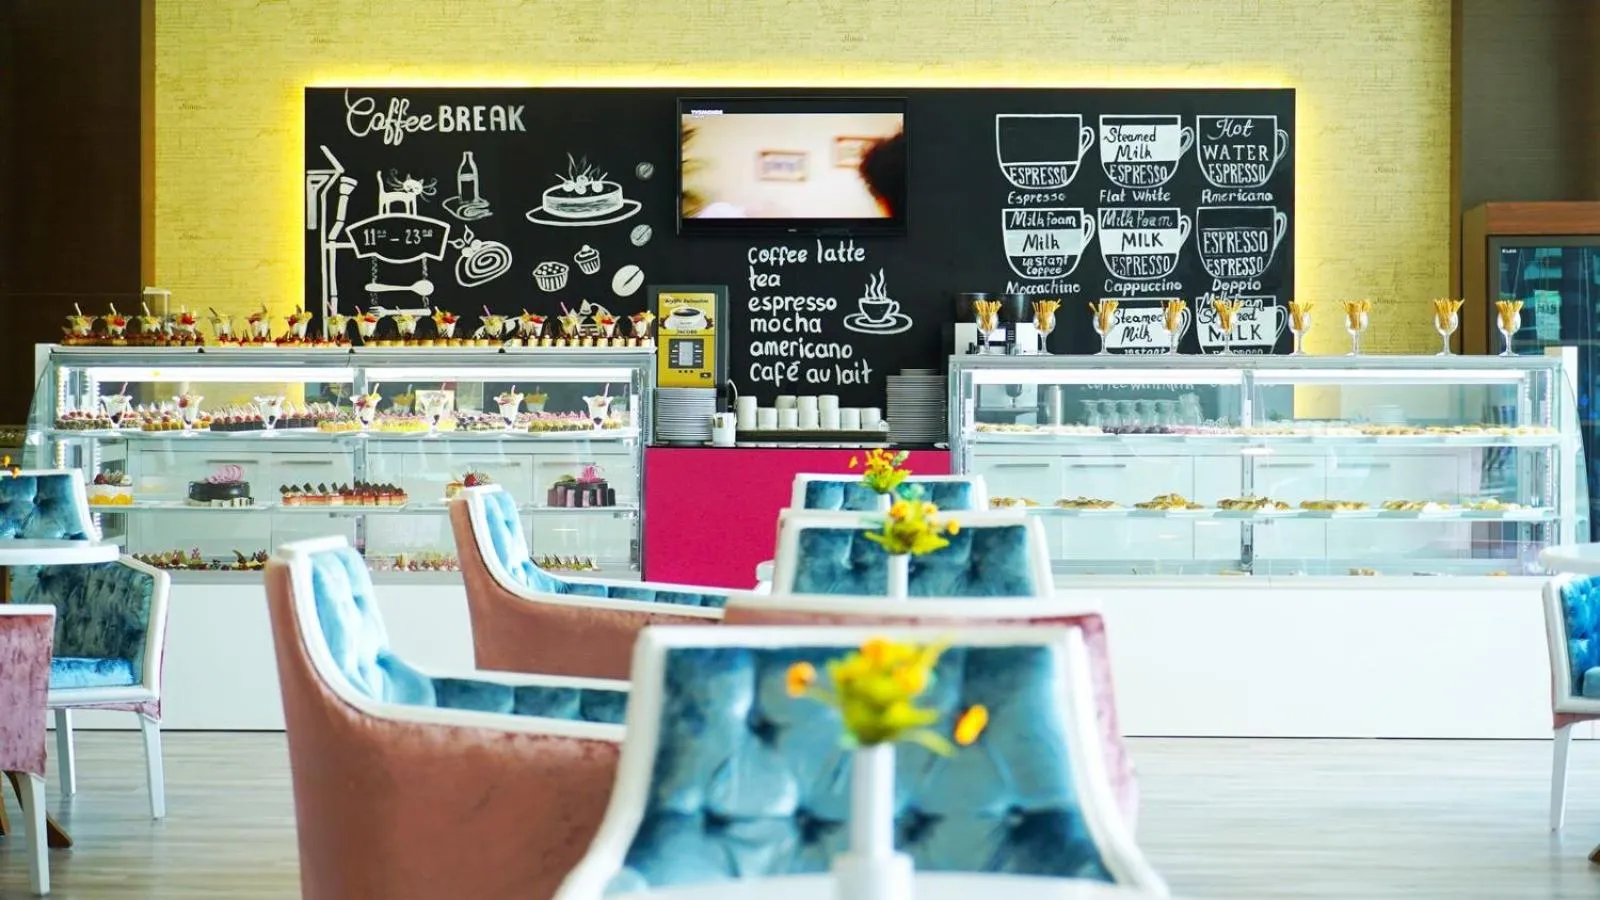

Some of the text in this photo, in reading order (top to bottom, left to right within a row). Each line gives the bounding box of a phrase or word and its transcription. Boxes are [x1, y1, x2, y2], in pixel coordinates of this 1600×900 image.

[345, 88, 527, 145] Coffee BREAK
[1103, 125, 1156, 143] Steamed
[1207, 117, 1255, 141] Hot
[1115, 143, 1153, 163] Milk
[1202, 144, 1270, 162] WATER
[1010, 164, 1068, 186] ESPRESSO
[1109, 161, 1168, 185] ESPRESSO
[1207, 162, 1266, 185] ESPRESSO
[1007, 191, 1066, 205] Espresso
[1100, 189, 1126, 203] Flat
[1201, 188, 1274, 203] Americano
[1009, 208, 1046, 228] Milk
[1101, 208, 1135, 228] Milk
[1022, 233, 1061, 253] Milk
[1120, 231, 1164, 250] MILK
[1203, 229, 1269, 254] ESPRESSO
[816, 239, 866, 264] latte
[1111, 254, 1171, 277] ESPRESSO
[1206, 256, 1265, 277] ESPRESSO
[748, 266, 782, 291] tea
[1104, 277, 1183, 296] Cappuccino
[1212, 277, 1262, 294] Doppio
[748, 296, 837, 317] espresso
[750, 312, 823, 333] mocha
[1121, 323, 1153, 345] Milk
[750, 336, 853, 360] americano
[805, 368, 831, 385] au
[834, 358, 873, 386] lait
